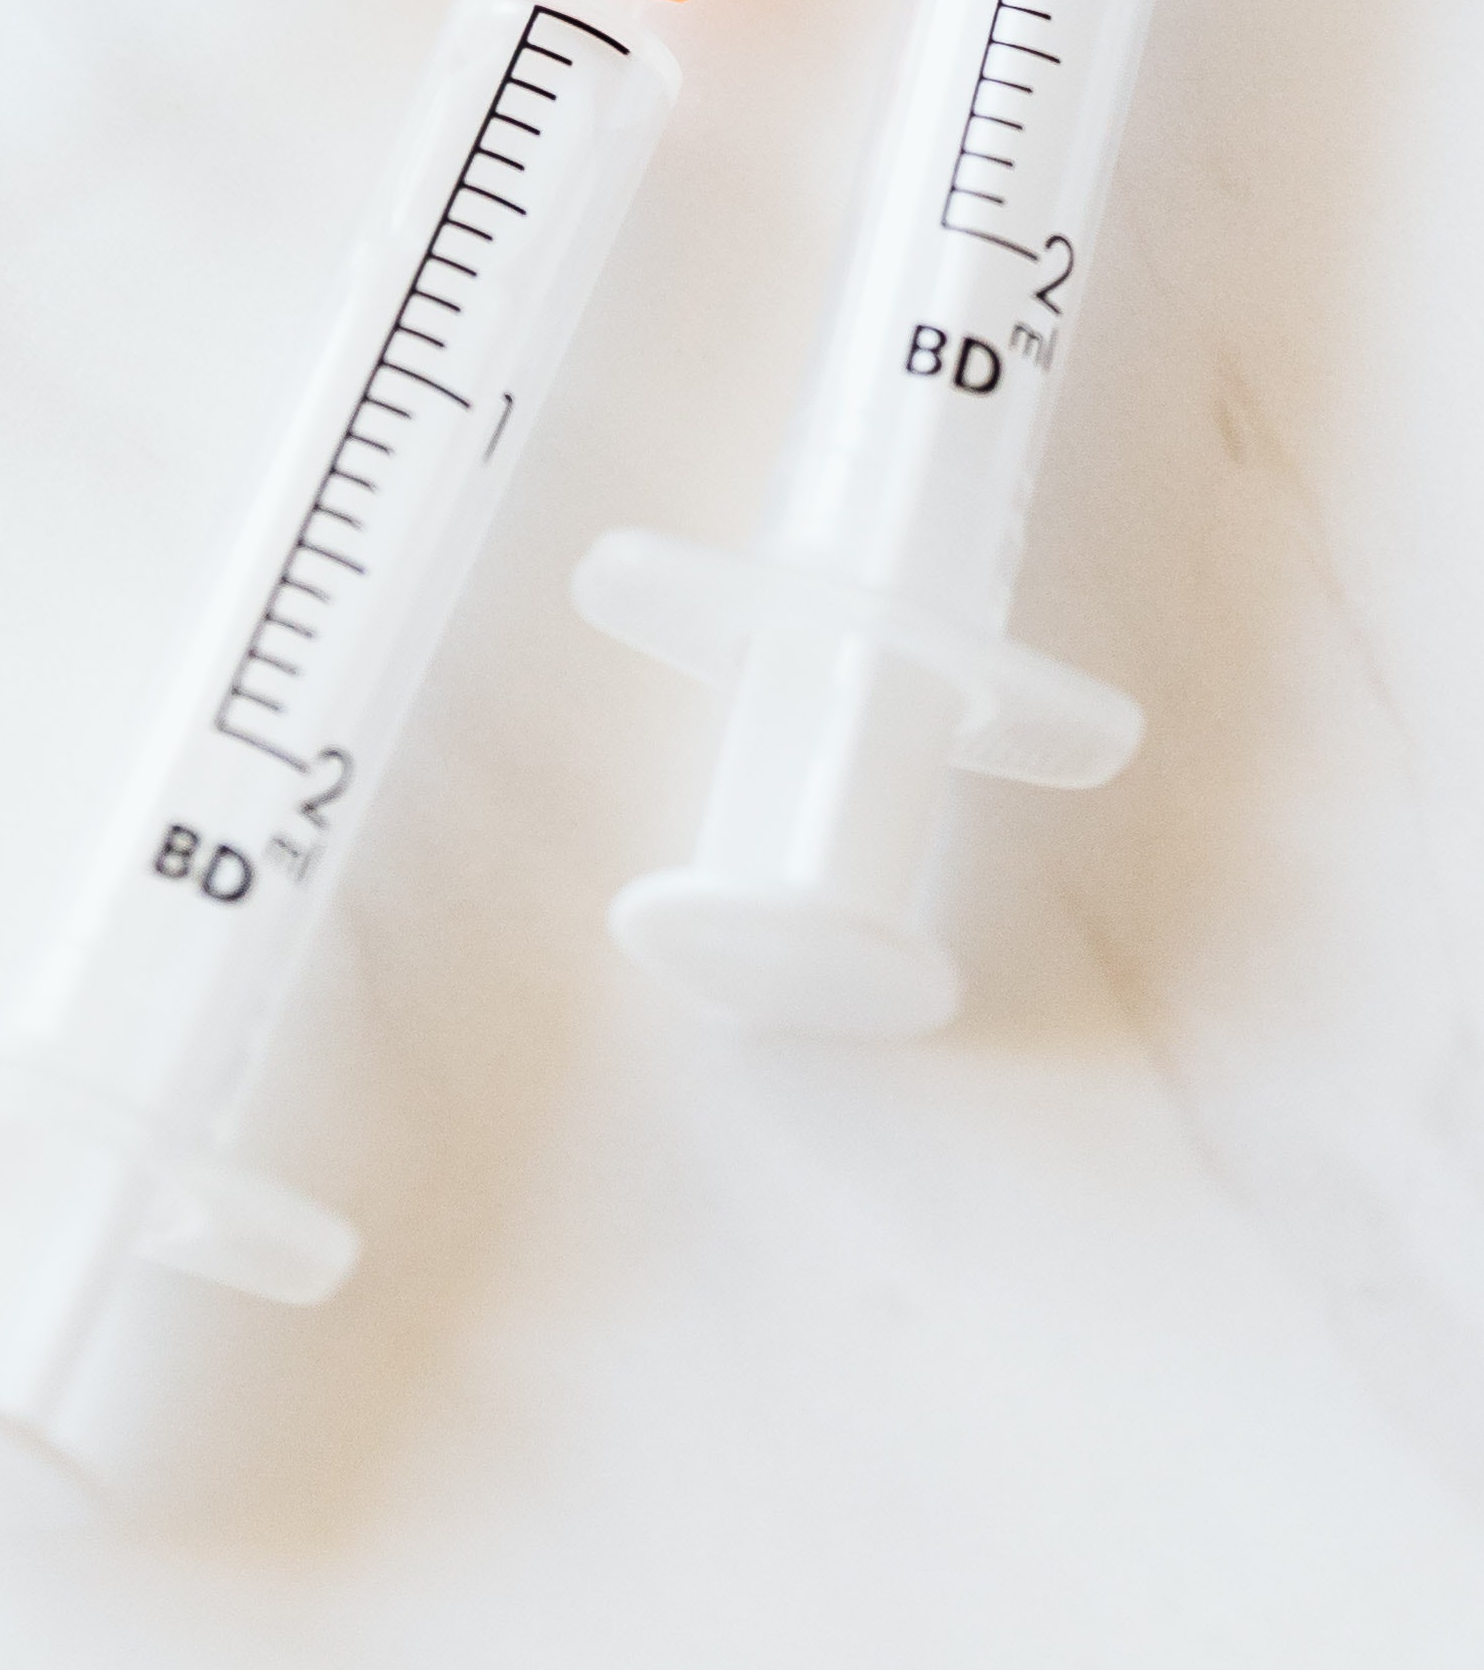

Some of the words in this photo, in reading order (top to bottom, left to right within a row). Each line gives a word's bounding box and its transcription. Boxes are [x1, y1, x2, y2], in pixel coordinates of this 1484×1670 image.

[1034, 234, 1075, 316] 2
[904, 322, 1003, 396] BD
[480, 392, 514, 466] 1
[299, 746, 355, 831] 2
[152, 823, 256, 906] BD
